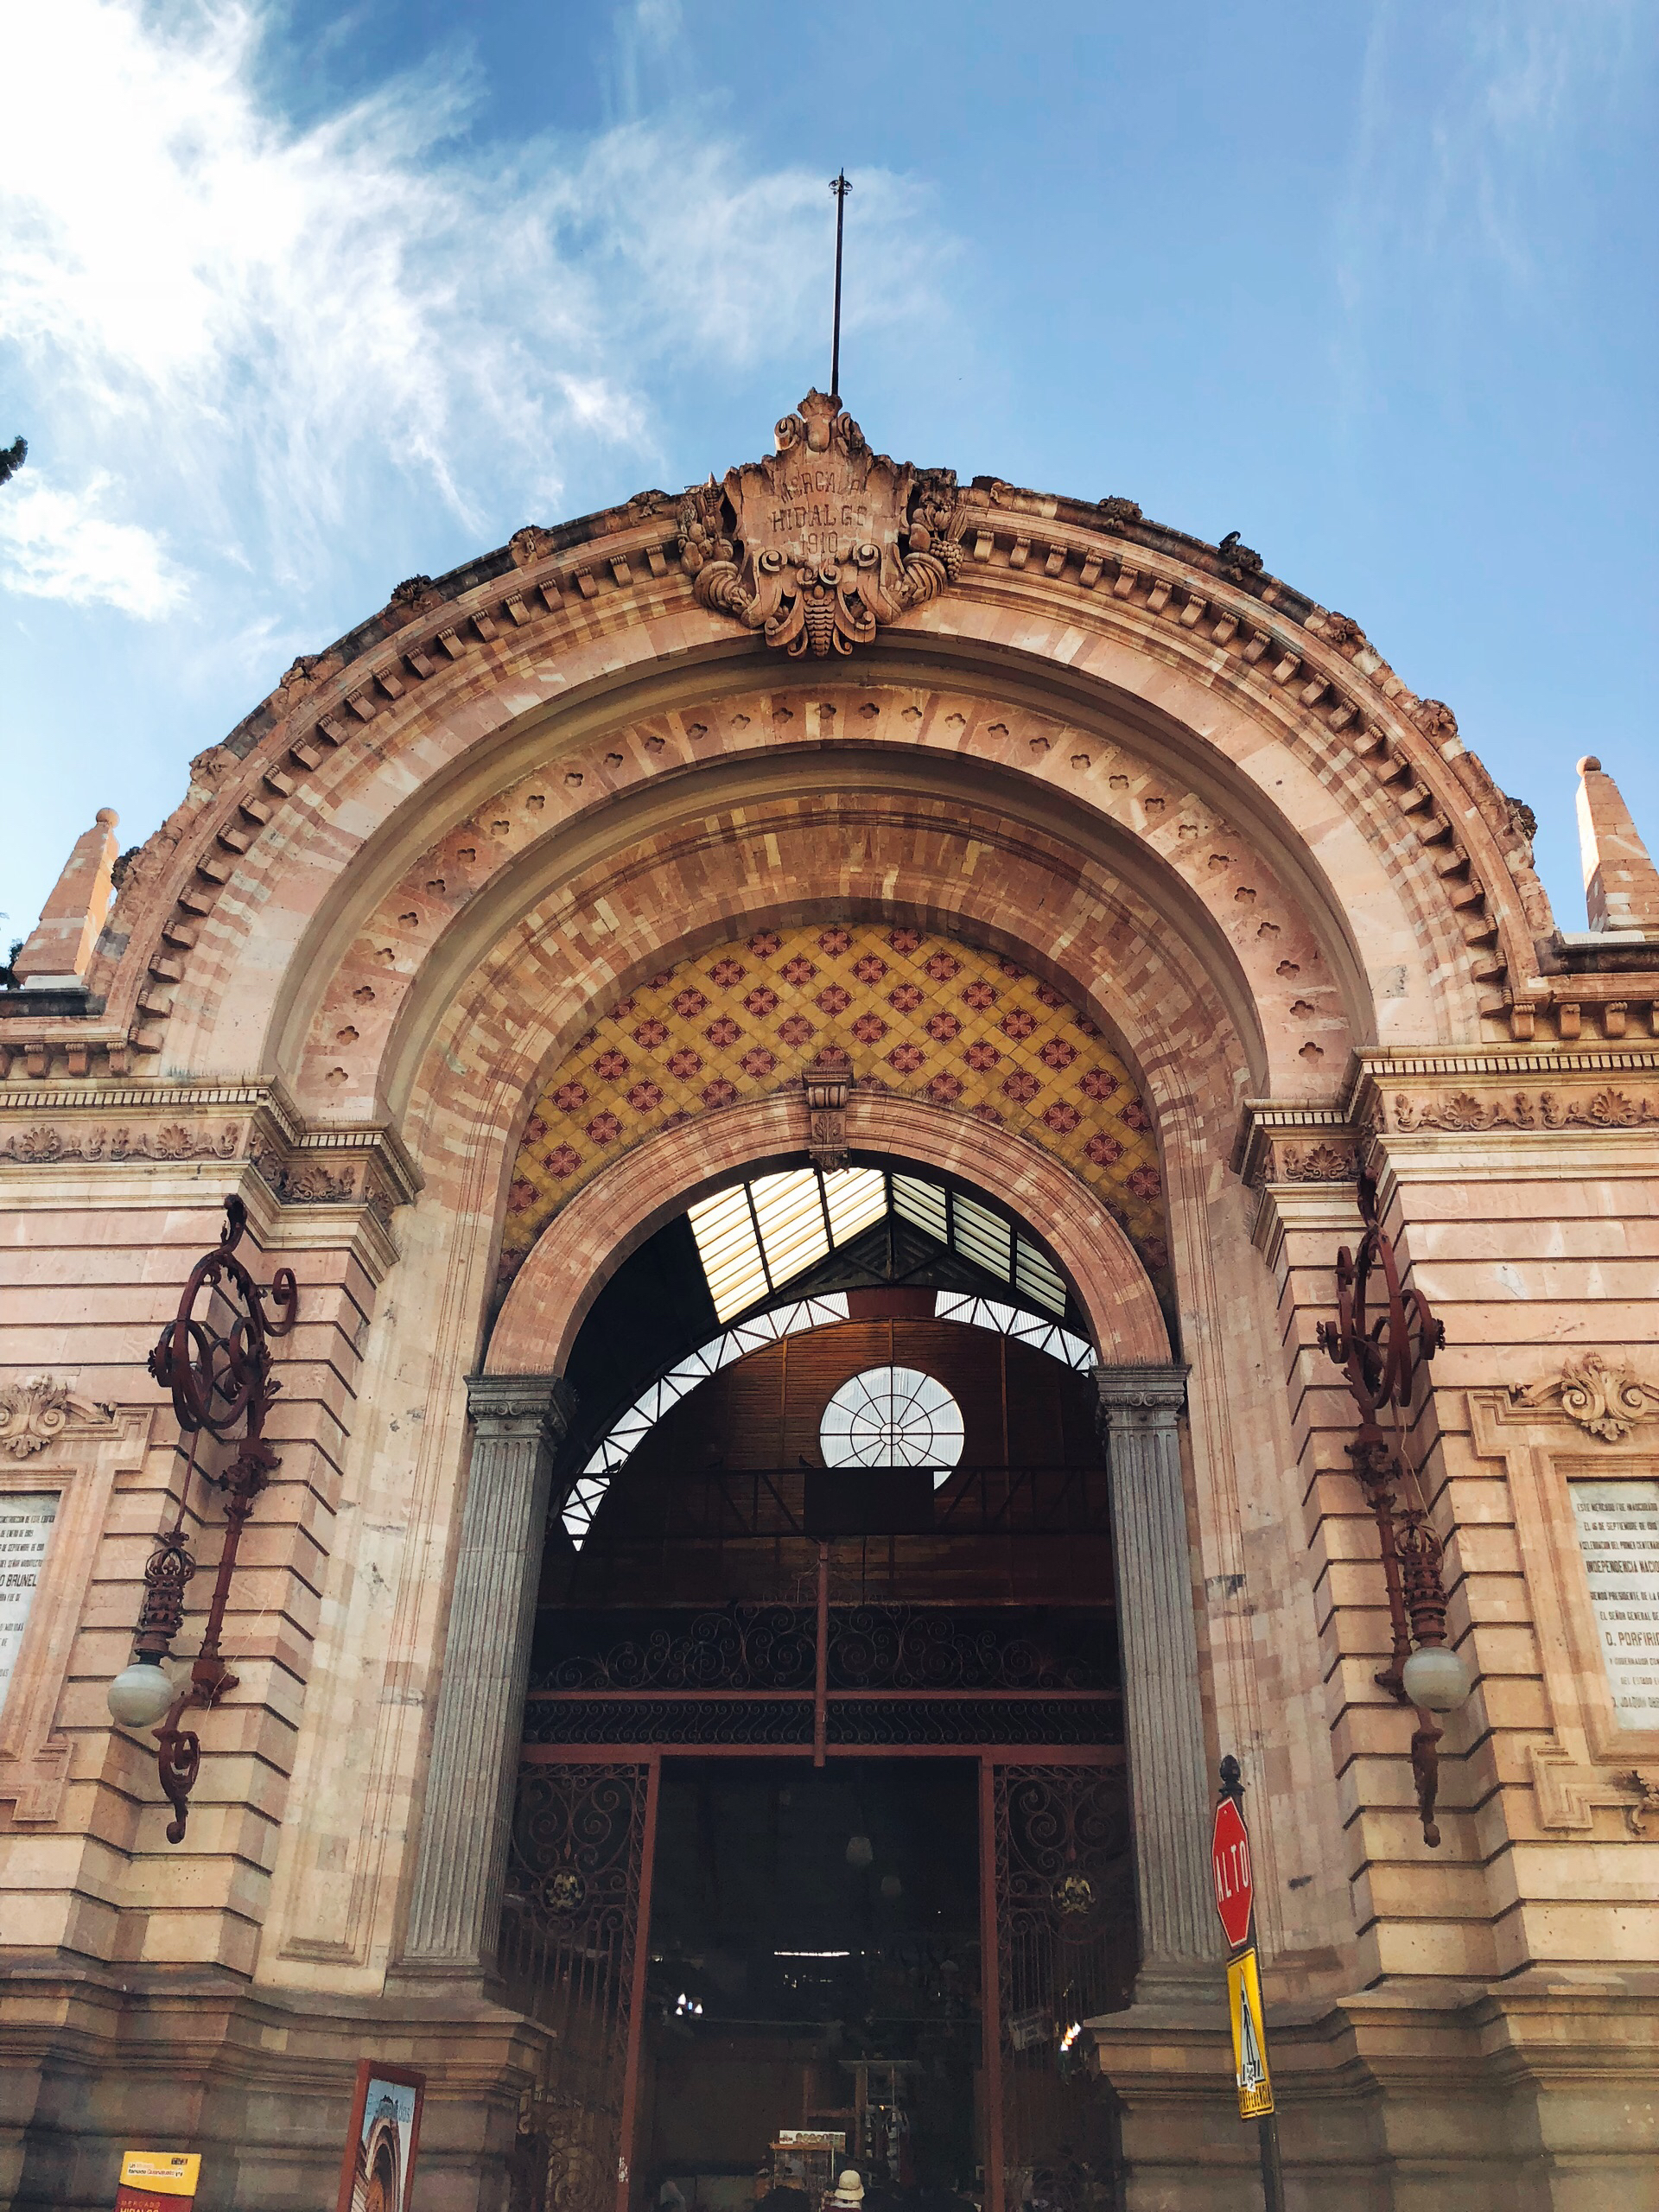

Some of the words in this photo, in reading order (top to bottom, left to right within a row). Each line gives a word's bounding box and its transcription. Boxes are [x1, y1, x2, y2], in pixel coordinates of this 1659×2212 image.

[772, 504, 867, 532] HIDALGO
[801, 531, 838, 556] 1910
[6, 1573, 37, 1587] BRUNEL
[1216, 1840, 1249, 1904] ALTO
[121, 2200, 161, 2209] MERCADO
